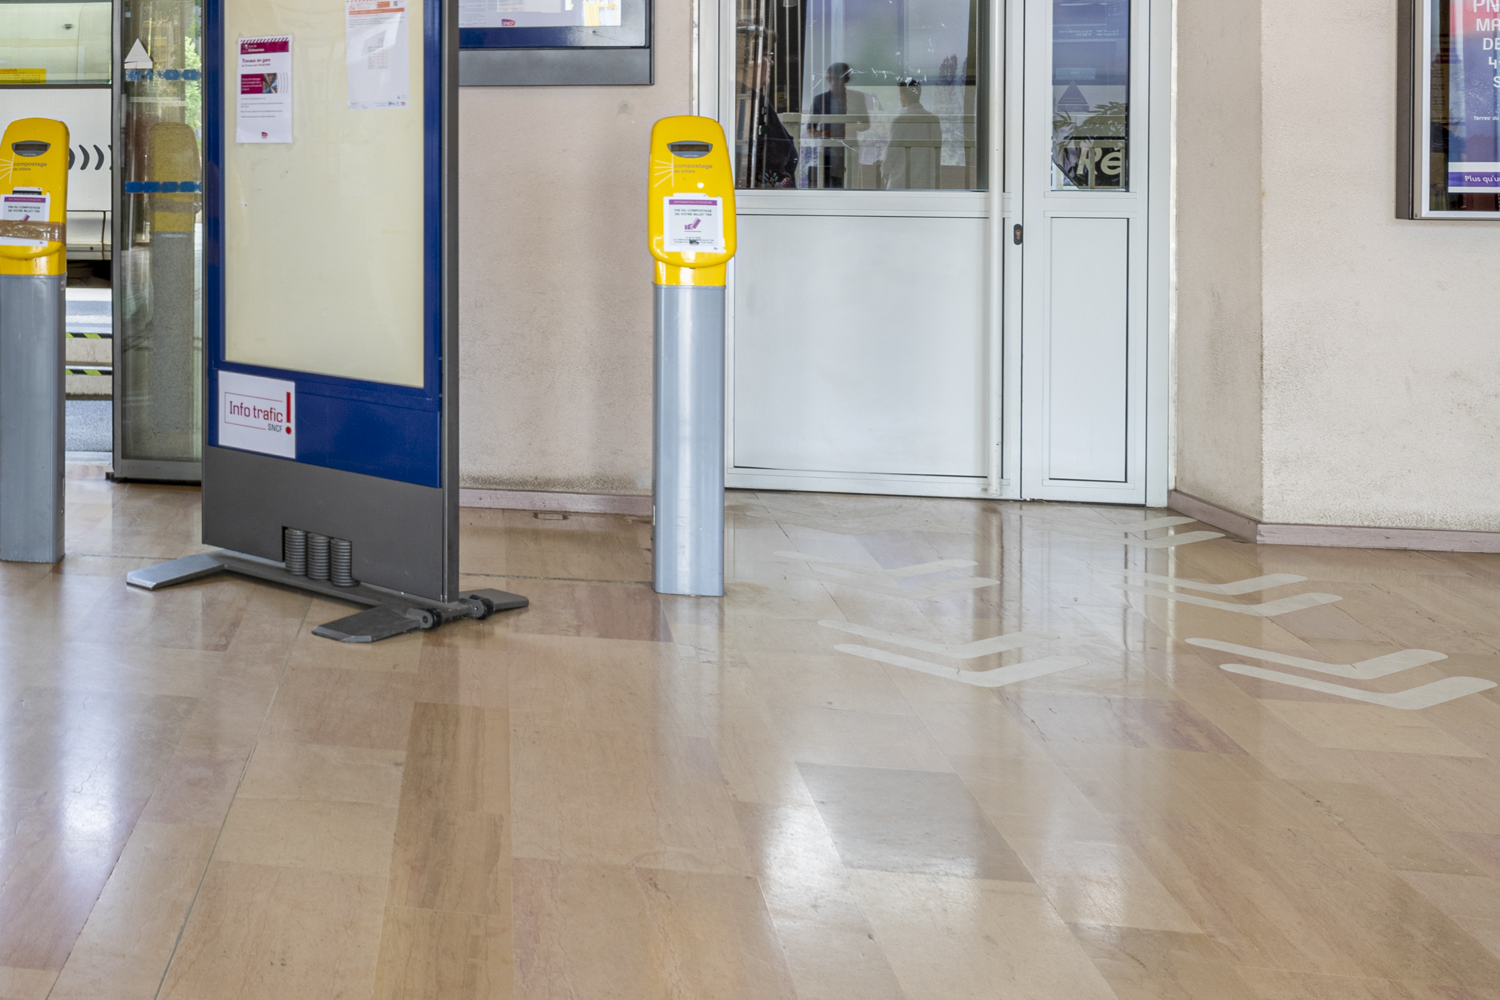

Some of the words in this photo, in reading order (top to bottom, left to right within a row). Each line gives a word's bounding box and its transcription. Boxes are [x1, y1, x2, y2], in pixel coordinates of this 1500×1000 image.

[230, 400, 251, 417] Info
[253, 405, 284, 423] trafic
[267, 423, 283, 433] SNCF
